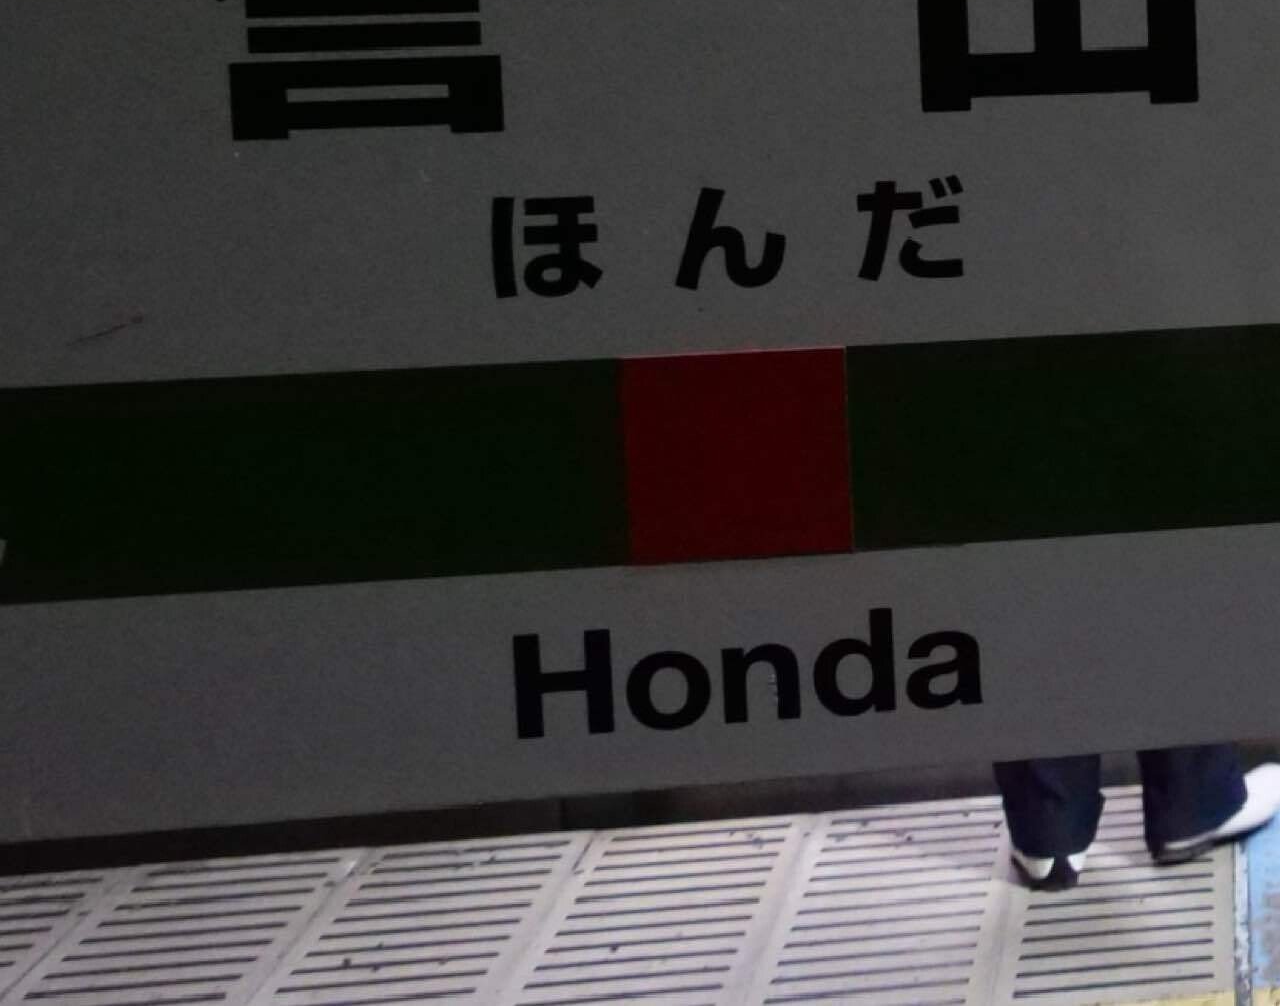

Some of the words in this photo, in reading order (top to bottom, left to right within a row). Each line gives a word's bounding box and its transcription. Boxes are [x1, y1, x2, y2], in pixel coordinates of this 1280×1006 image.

[491, 175, 964, 298] ほんだ
[512, 608, 983, 740] Honda
